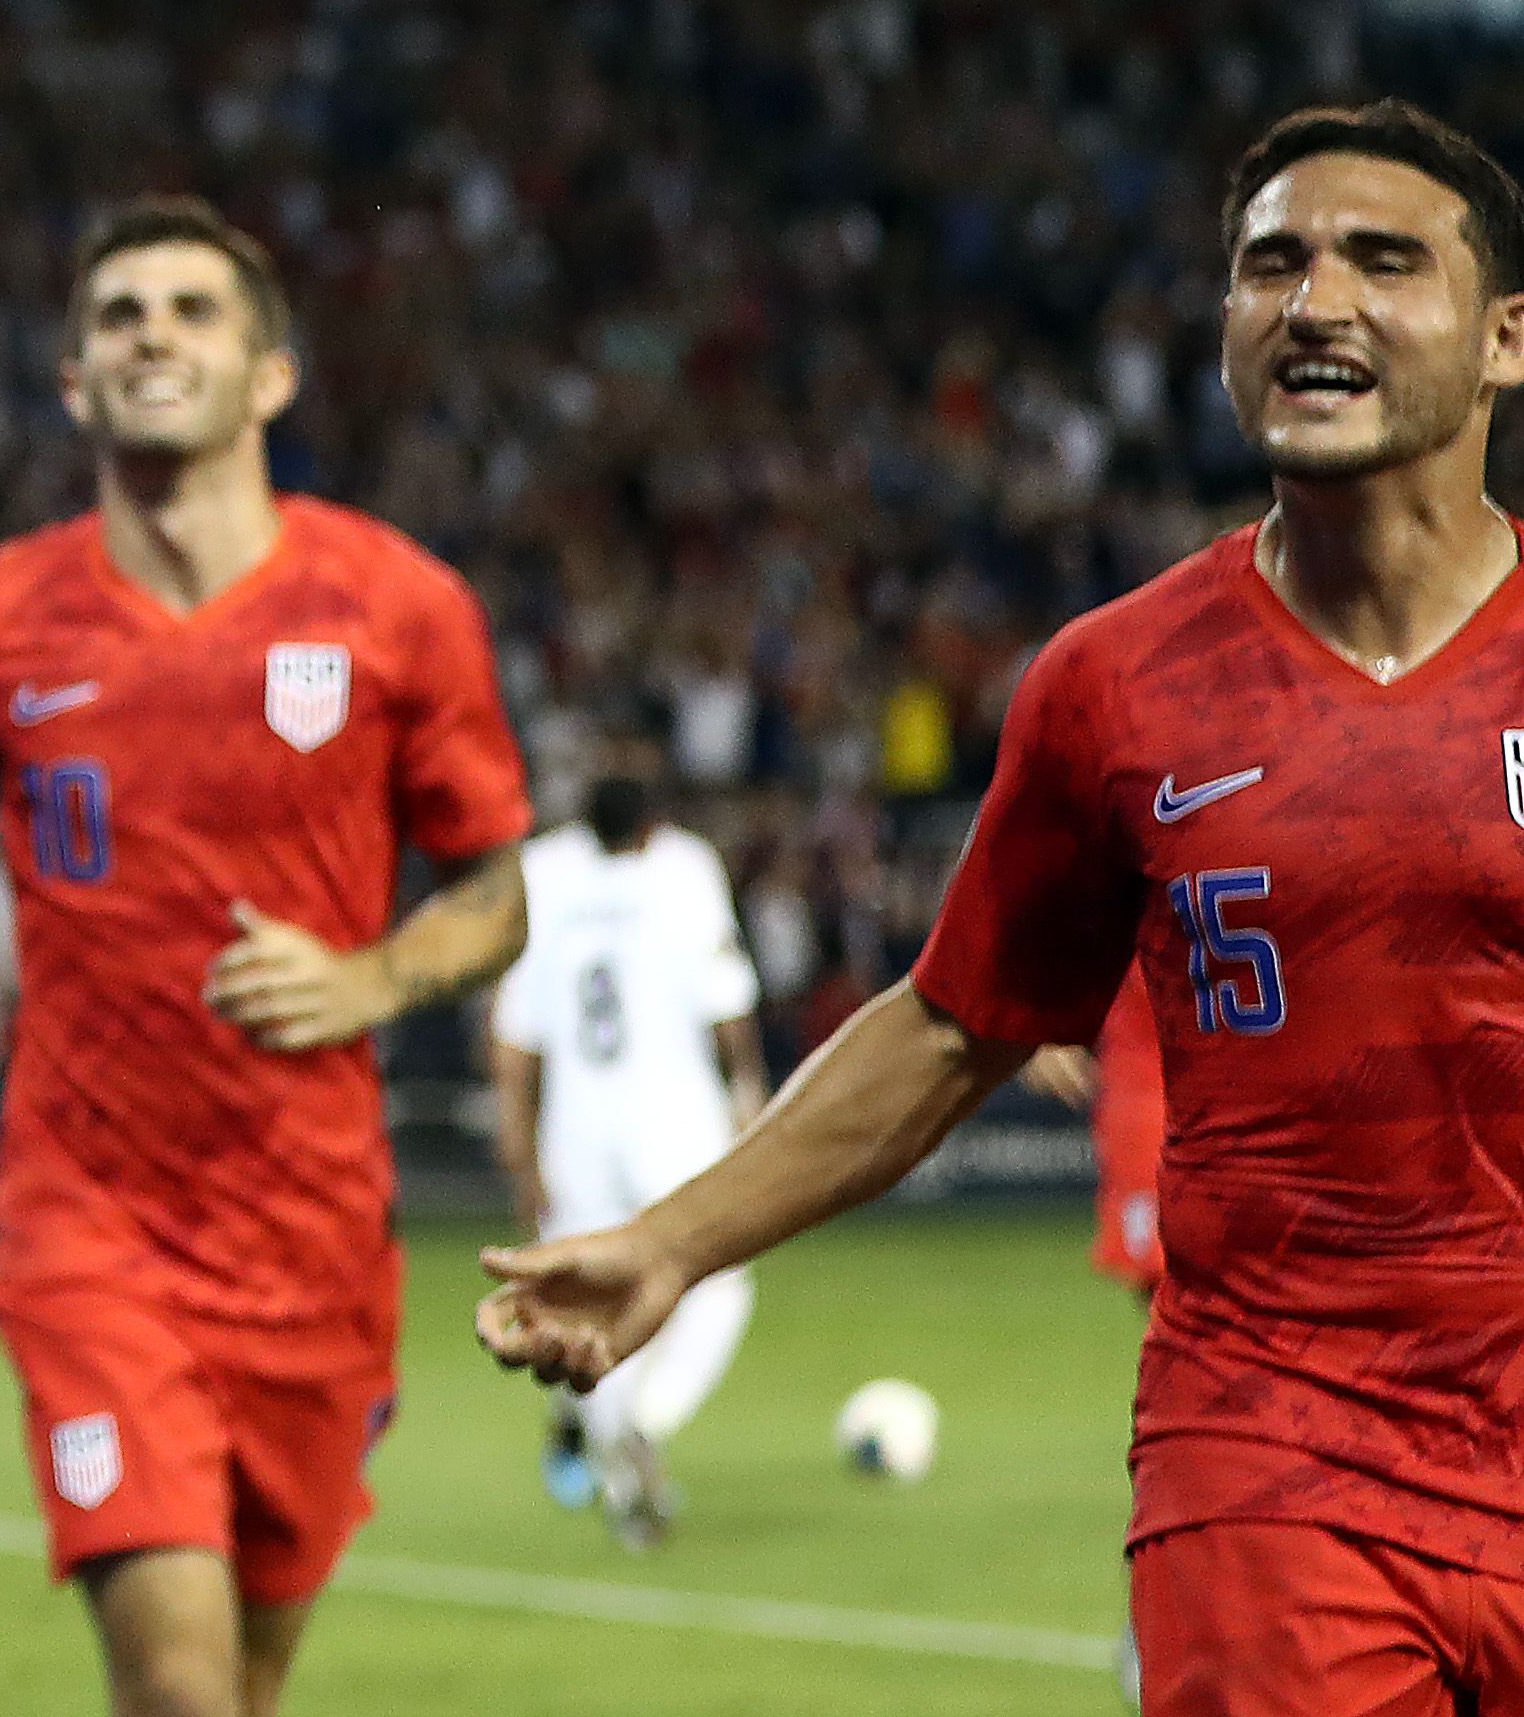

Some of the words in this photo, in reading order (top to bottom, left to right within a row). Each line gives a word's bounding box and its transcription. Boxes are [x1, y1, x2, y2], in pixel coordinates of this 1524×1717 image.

[20, 756, 111, 882] 10
[576, 952, 632, 1067] 8
[1166, 865, 1287, 1035] 15
